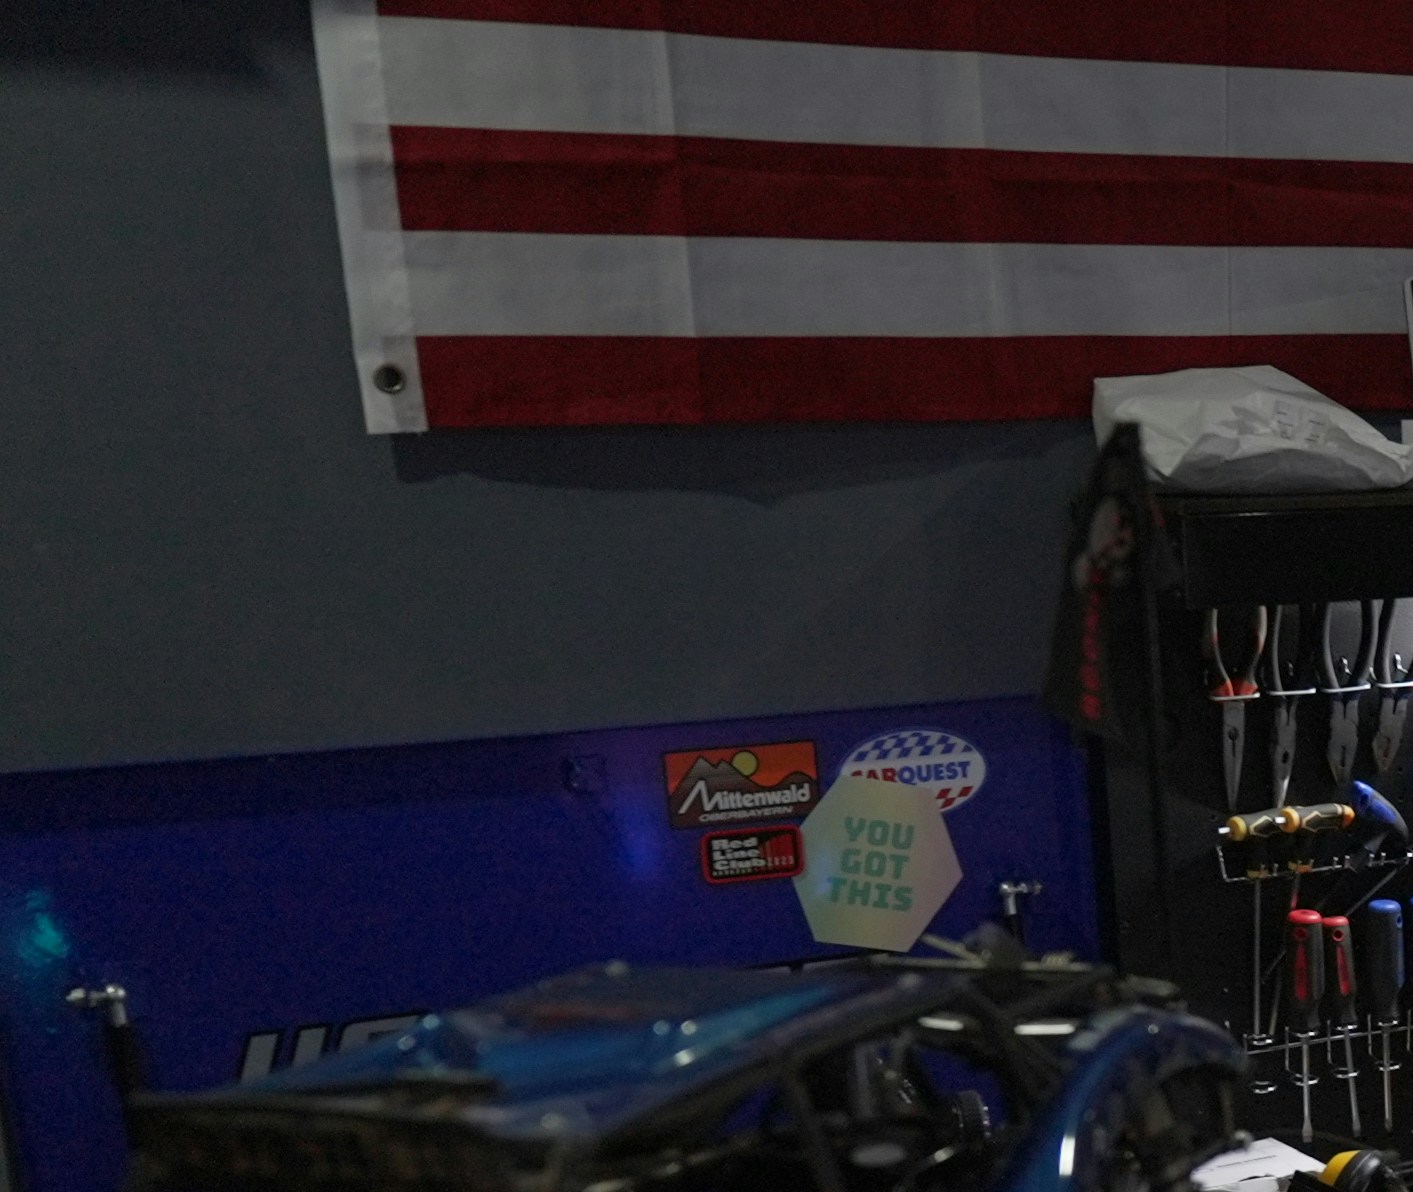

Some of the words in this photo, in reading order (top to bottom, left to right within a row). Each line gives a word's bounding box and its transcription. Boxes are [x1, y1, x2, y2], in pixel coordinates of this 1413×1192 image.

[678, 779, 811, 815] Mittenwald
[699, 805, 794, 822] OBERBAYERN
[711, 837, 758, 851] Red
[844, 815, 915, 850] YOU
[711, 848, 761, 861] Line
[711, 857, 767, 871] Club
[840, 849, 911, 879] GOT
[827, 876, 914, 912] THIS
